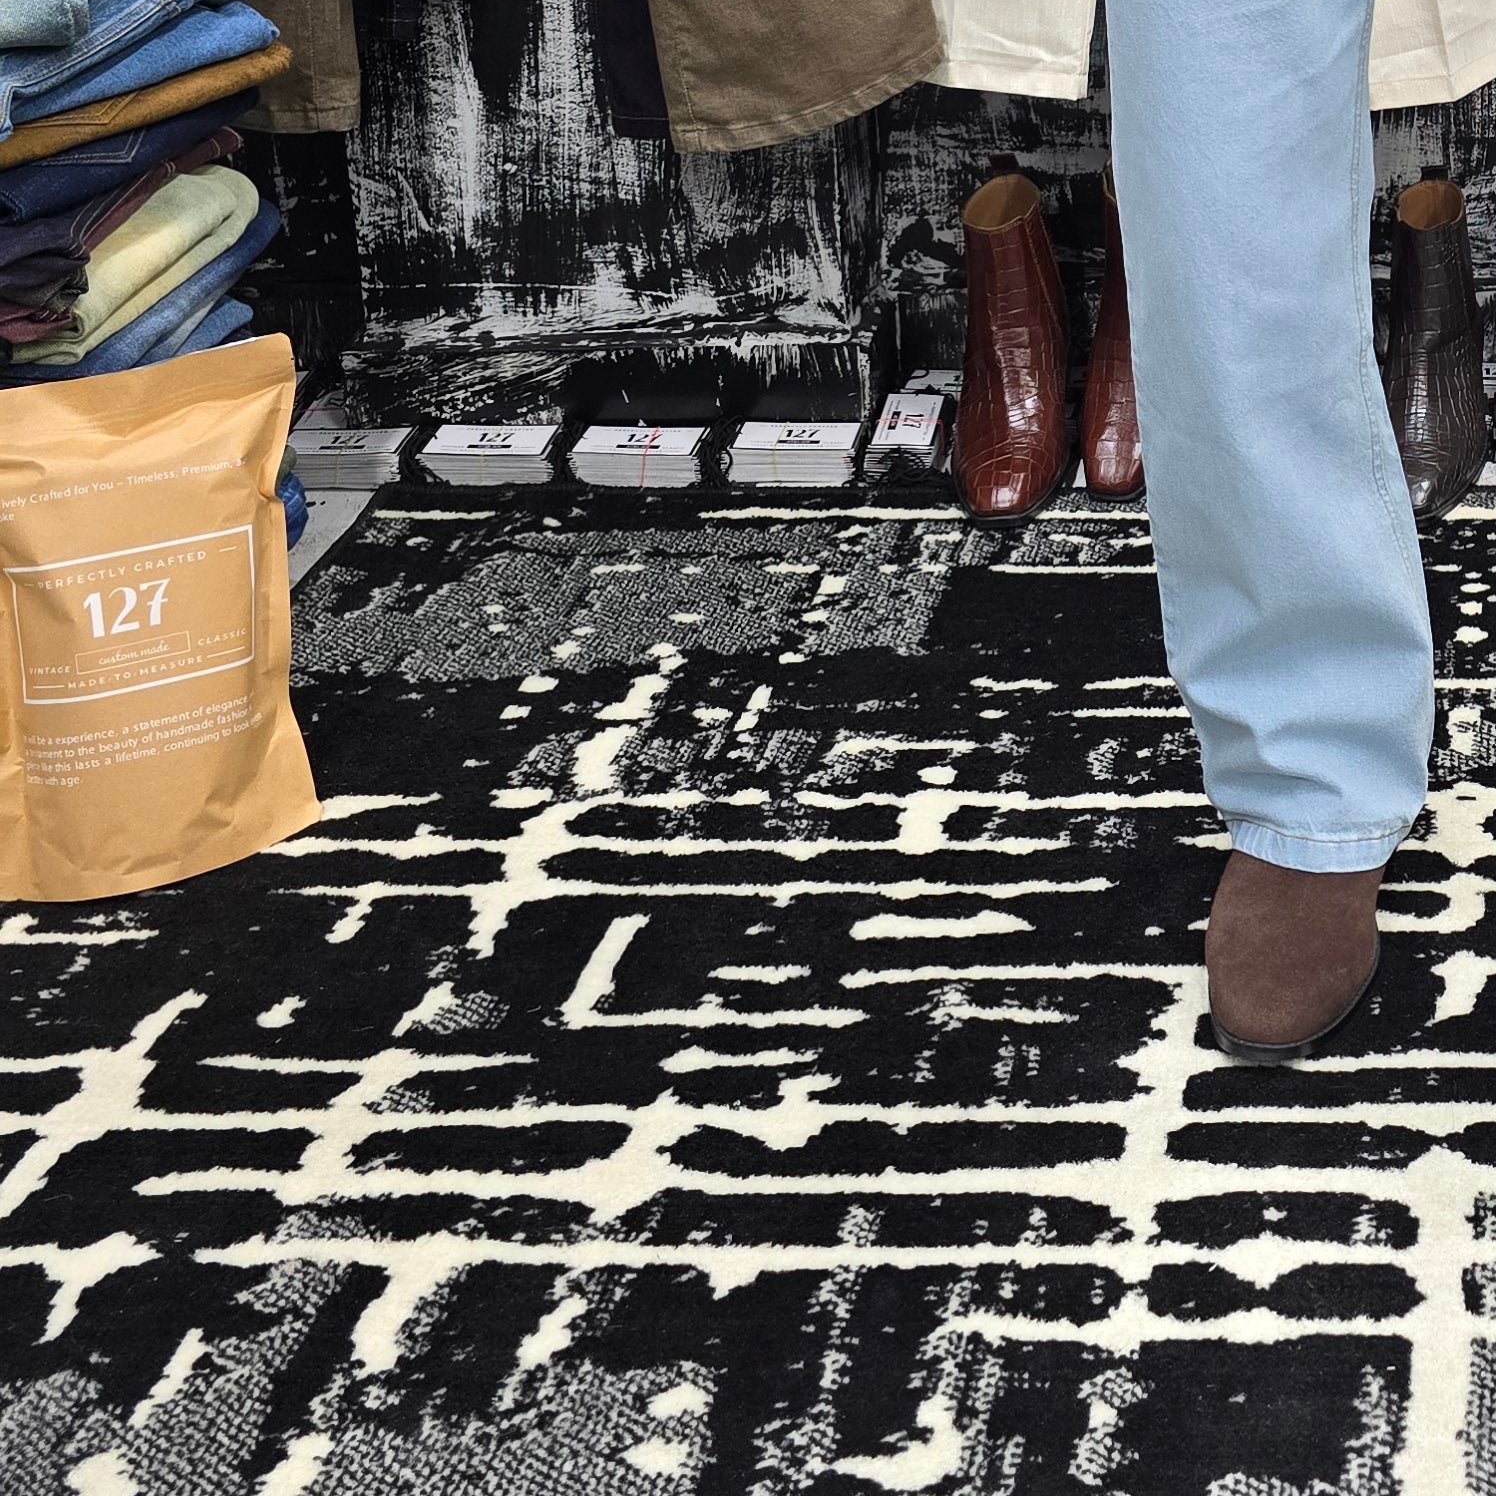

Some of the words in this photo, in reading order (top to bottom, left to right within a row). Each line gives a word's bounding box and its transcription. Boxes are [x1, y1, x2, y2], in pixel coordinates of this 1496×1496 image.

[479, 432, 515, 442] 127
[785, 429, 820, 438] 127
[0, 496, 26, 508] ively
[30, 487, 71, 503] Crafted
[74, 485, 89, 496] for
[92, 482, 114, 492] You
[127, 470, 180, 485] Timeless,
[182, 461, 233, 476] Premium,
[38, 566, 126, 590] PERFECTLY
[134, 550, 207, 572] CRAFTED
[83, 577, 171, 638] 127
[29, 665, 71, 675] VINTAGE
[98, 649, 139, 665] custom
[140, 640, 171, 656] made
[197, 627, 248, 646] CLASSIC
[65, 749, 75, 758] to
[77, 746, 96, 756] the
[99, 738, 138, 753] beauty
[141, 731, 153, 744] of
[156, 719, 214, 740] handmade
[122, 726, 129, 735] a
[133, 712, 191, 732] statement
[192, 706, 203, 718] of
[55, 761, 71, 772] this
[75, 759, 100, 770] lasts
[164, 731, 220, 752] continuing
[222, 728, 231, 737] to
[233, 719, 250, 733] look
